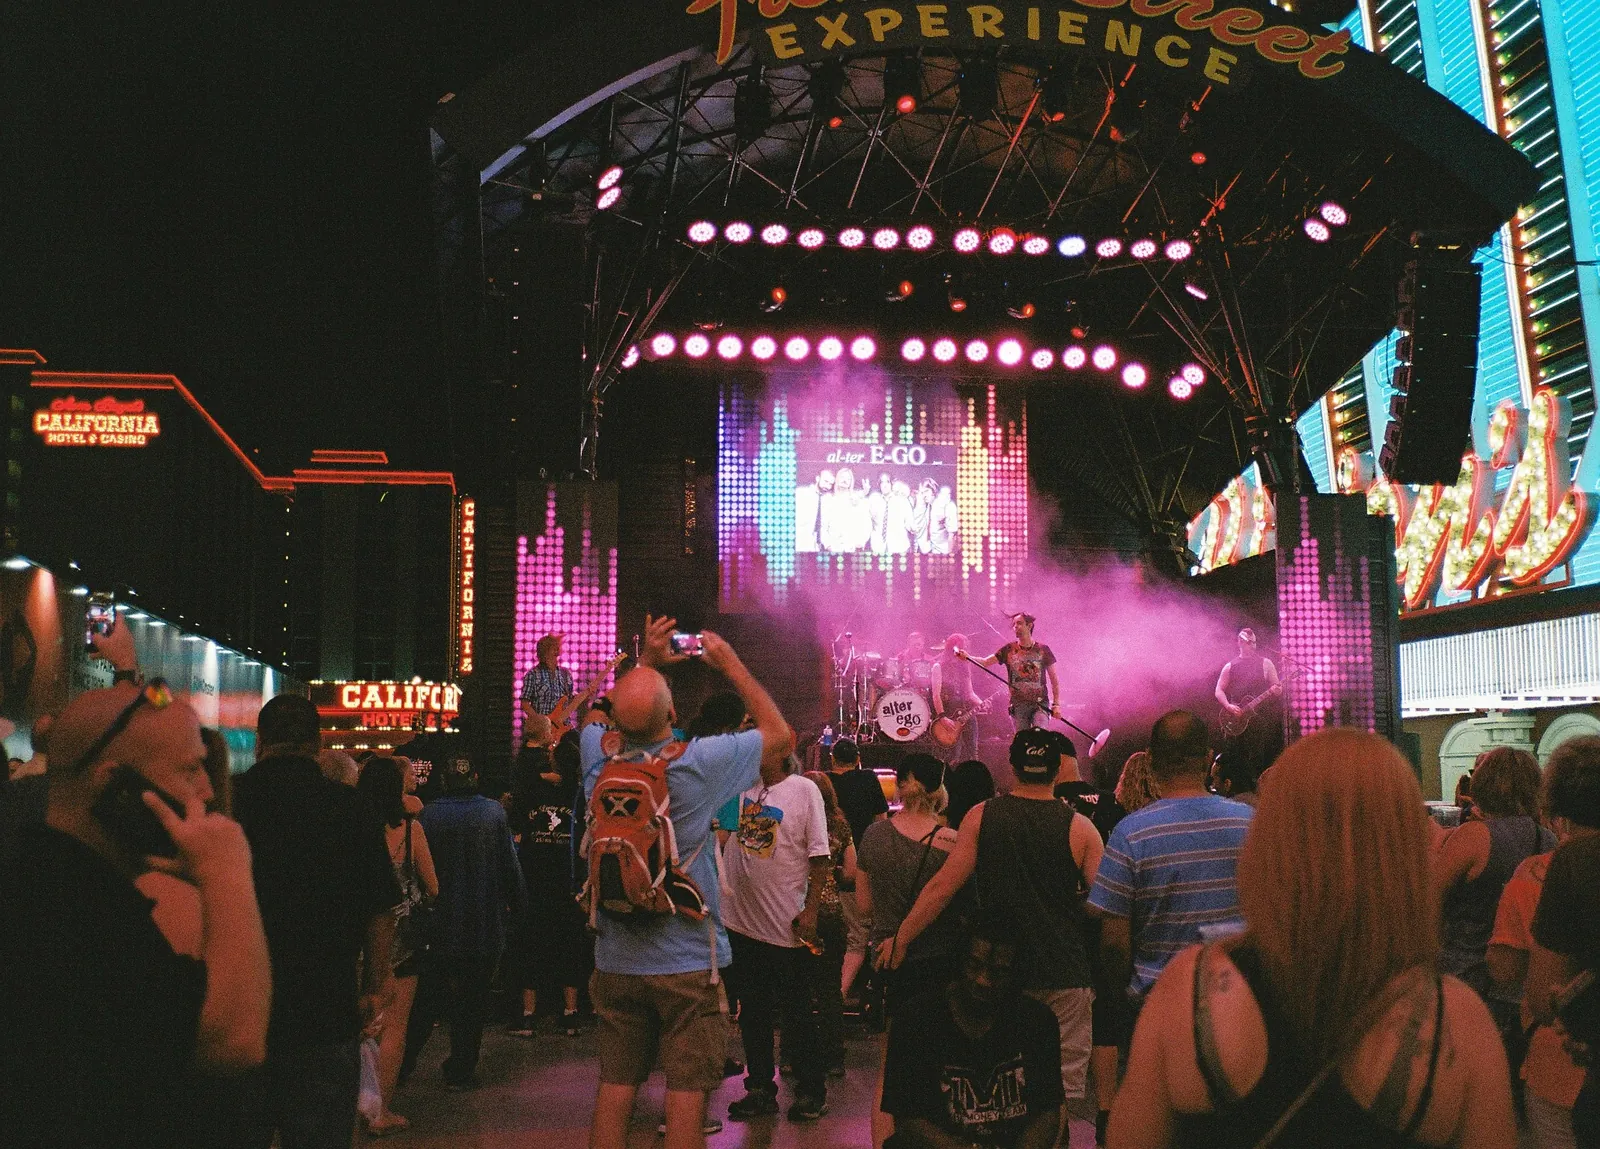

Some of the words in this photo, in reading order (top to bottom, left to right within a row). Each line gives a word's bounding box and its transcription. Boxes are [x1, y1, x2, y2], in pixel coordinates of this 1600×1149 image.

[765, 4, 1239, 86] EXPERIENCE
[1070, 0, 1352, 79] reet
[36, 412, 159, 434] CALIFORNIA
[47, 433, 87, 443] HOTEL
[100, 433, 146, 445] CASINO
[826, 448, 865, 464] al-ter
[869, 445, 926, 466] E-GO
[461, 502, 476, 673] CALIFORNIA
[342, 685, 458, 711] CALIFOR
[882, 701, 913, 716] alter
[362, 713, 420, 727] HOTE
[896, 713, 921, 728] ego
